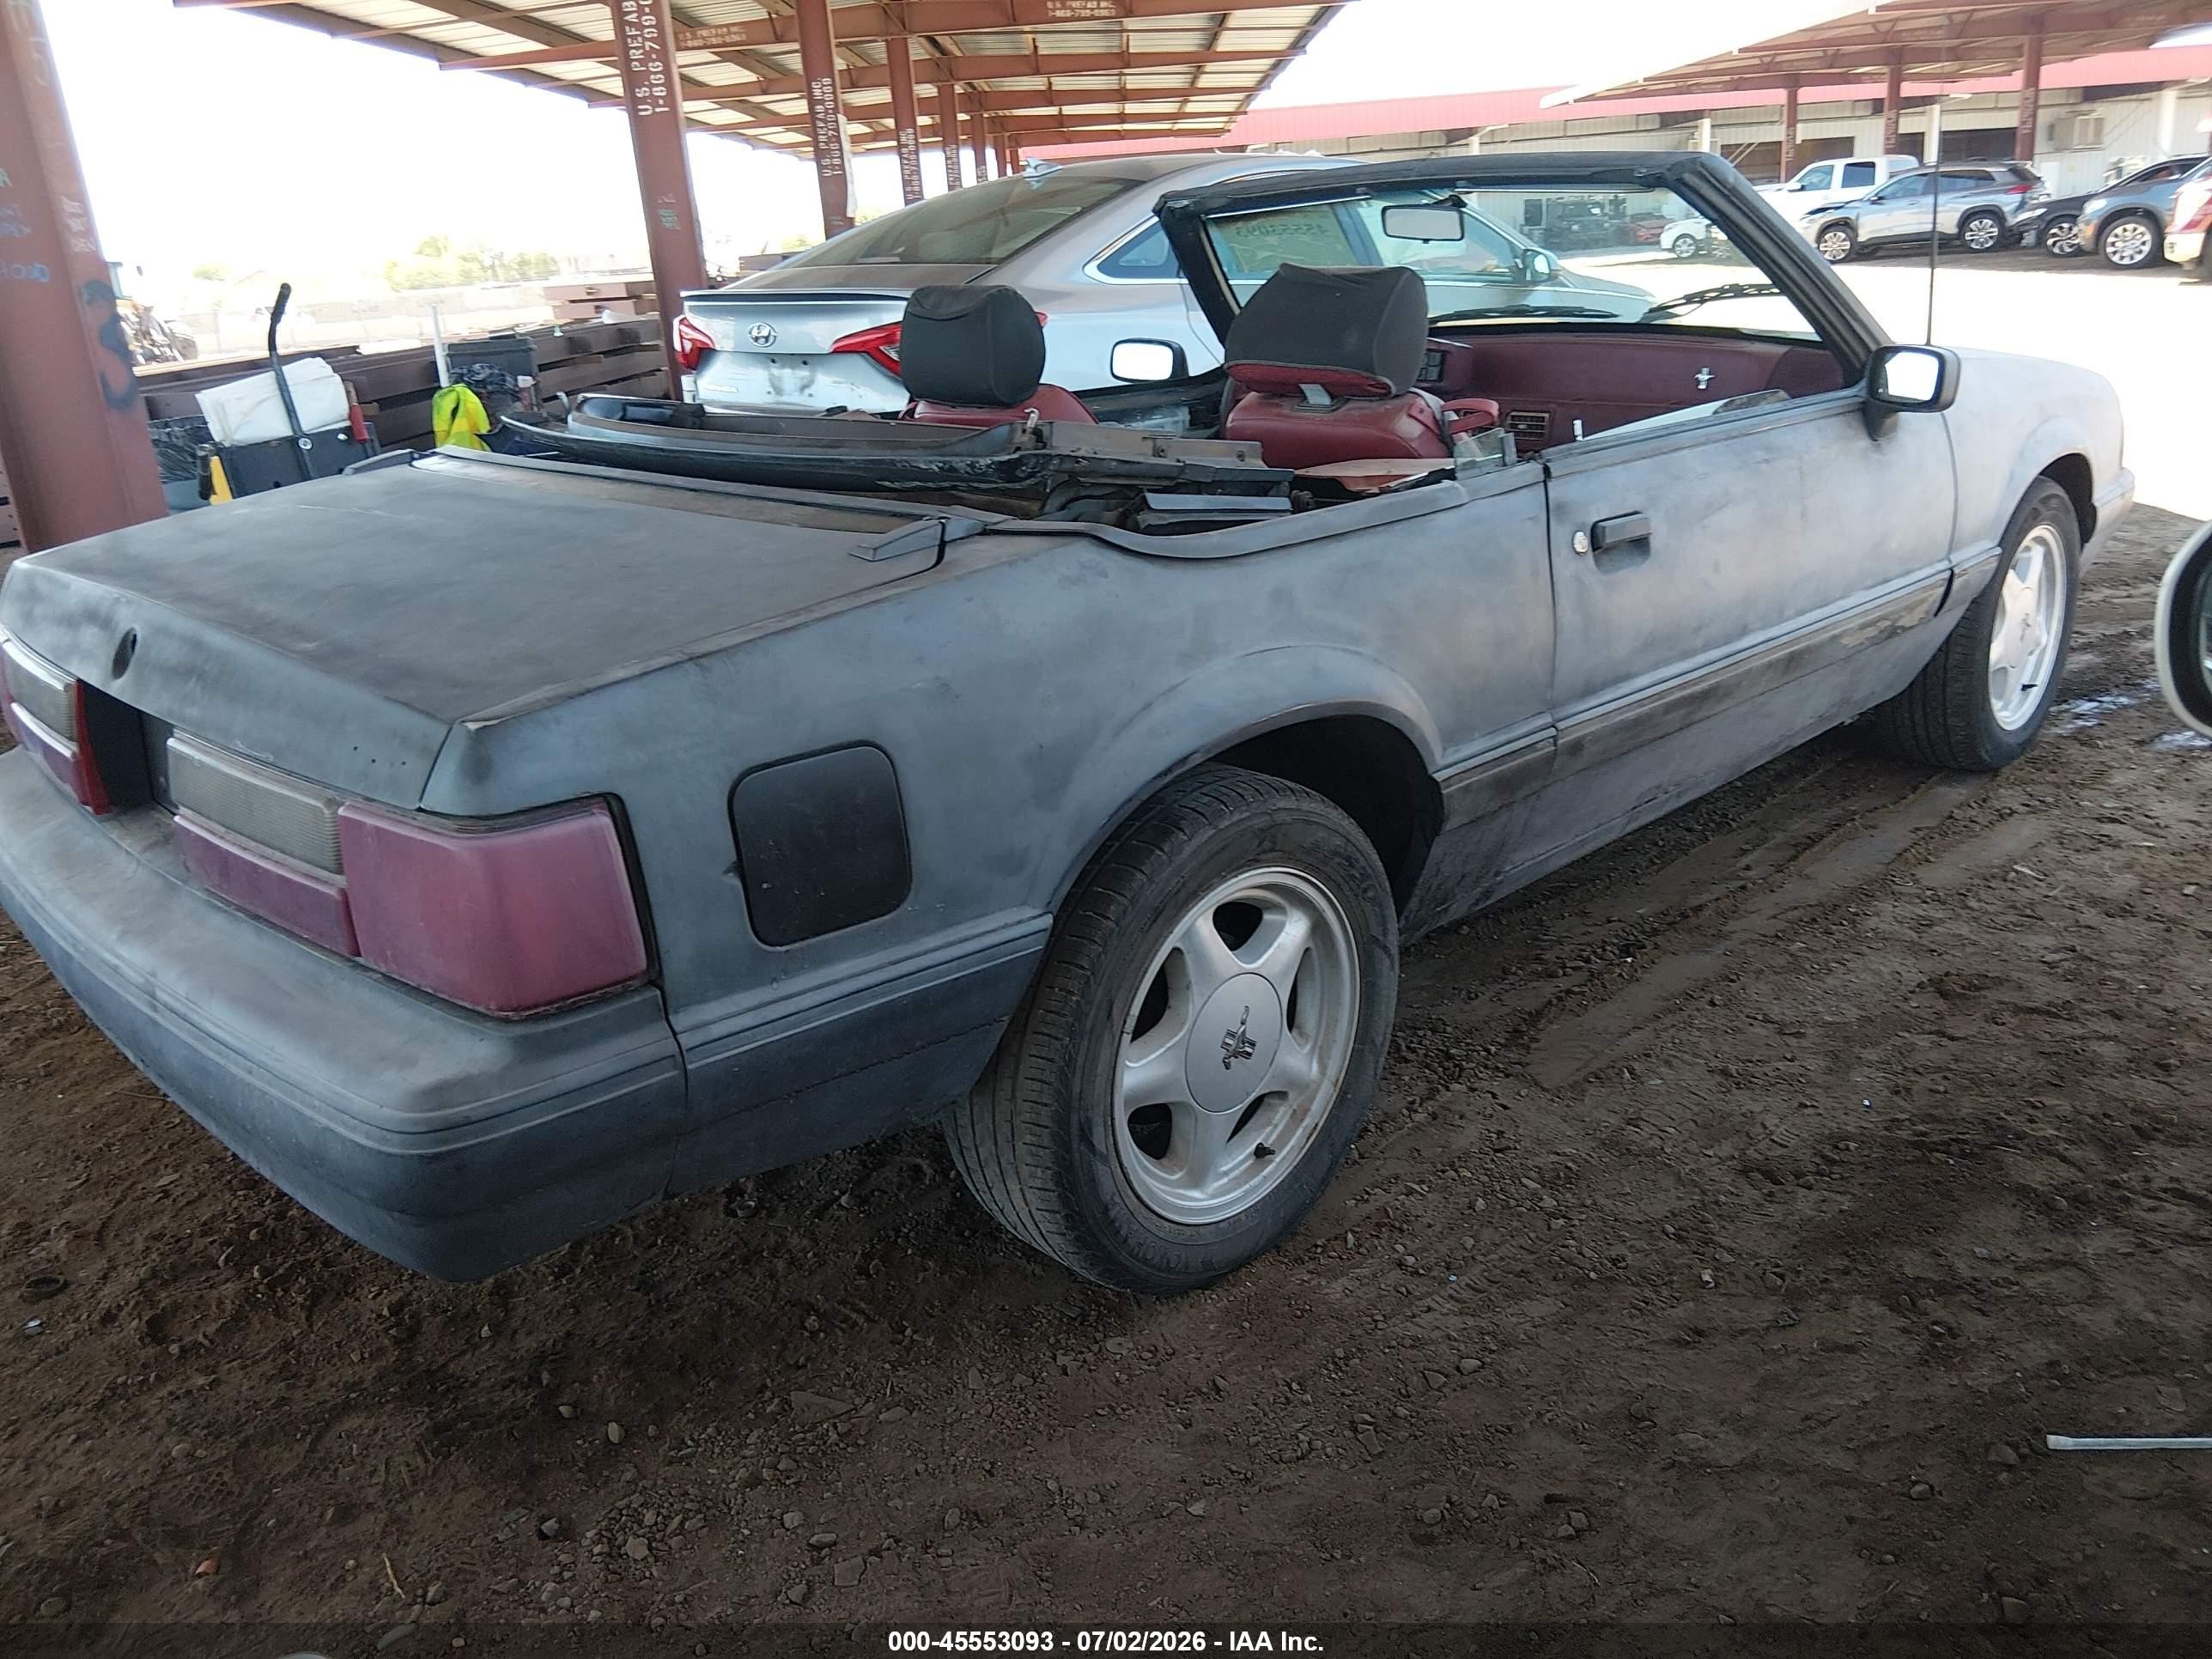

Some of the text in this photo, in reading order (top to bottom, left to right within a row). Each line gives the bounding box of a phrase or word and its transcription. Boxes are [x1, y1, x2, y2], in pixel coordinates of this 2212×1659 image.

[622, 0, 653, 116] U.S. PREFAB
[811, 77, 834, 177] U.S. PREFAB INC.
